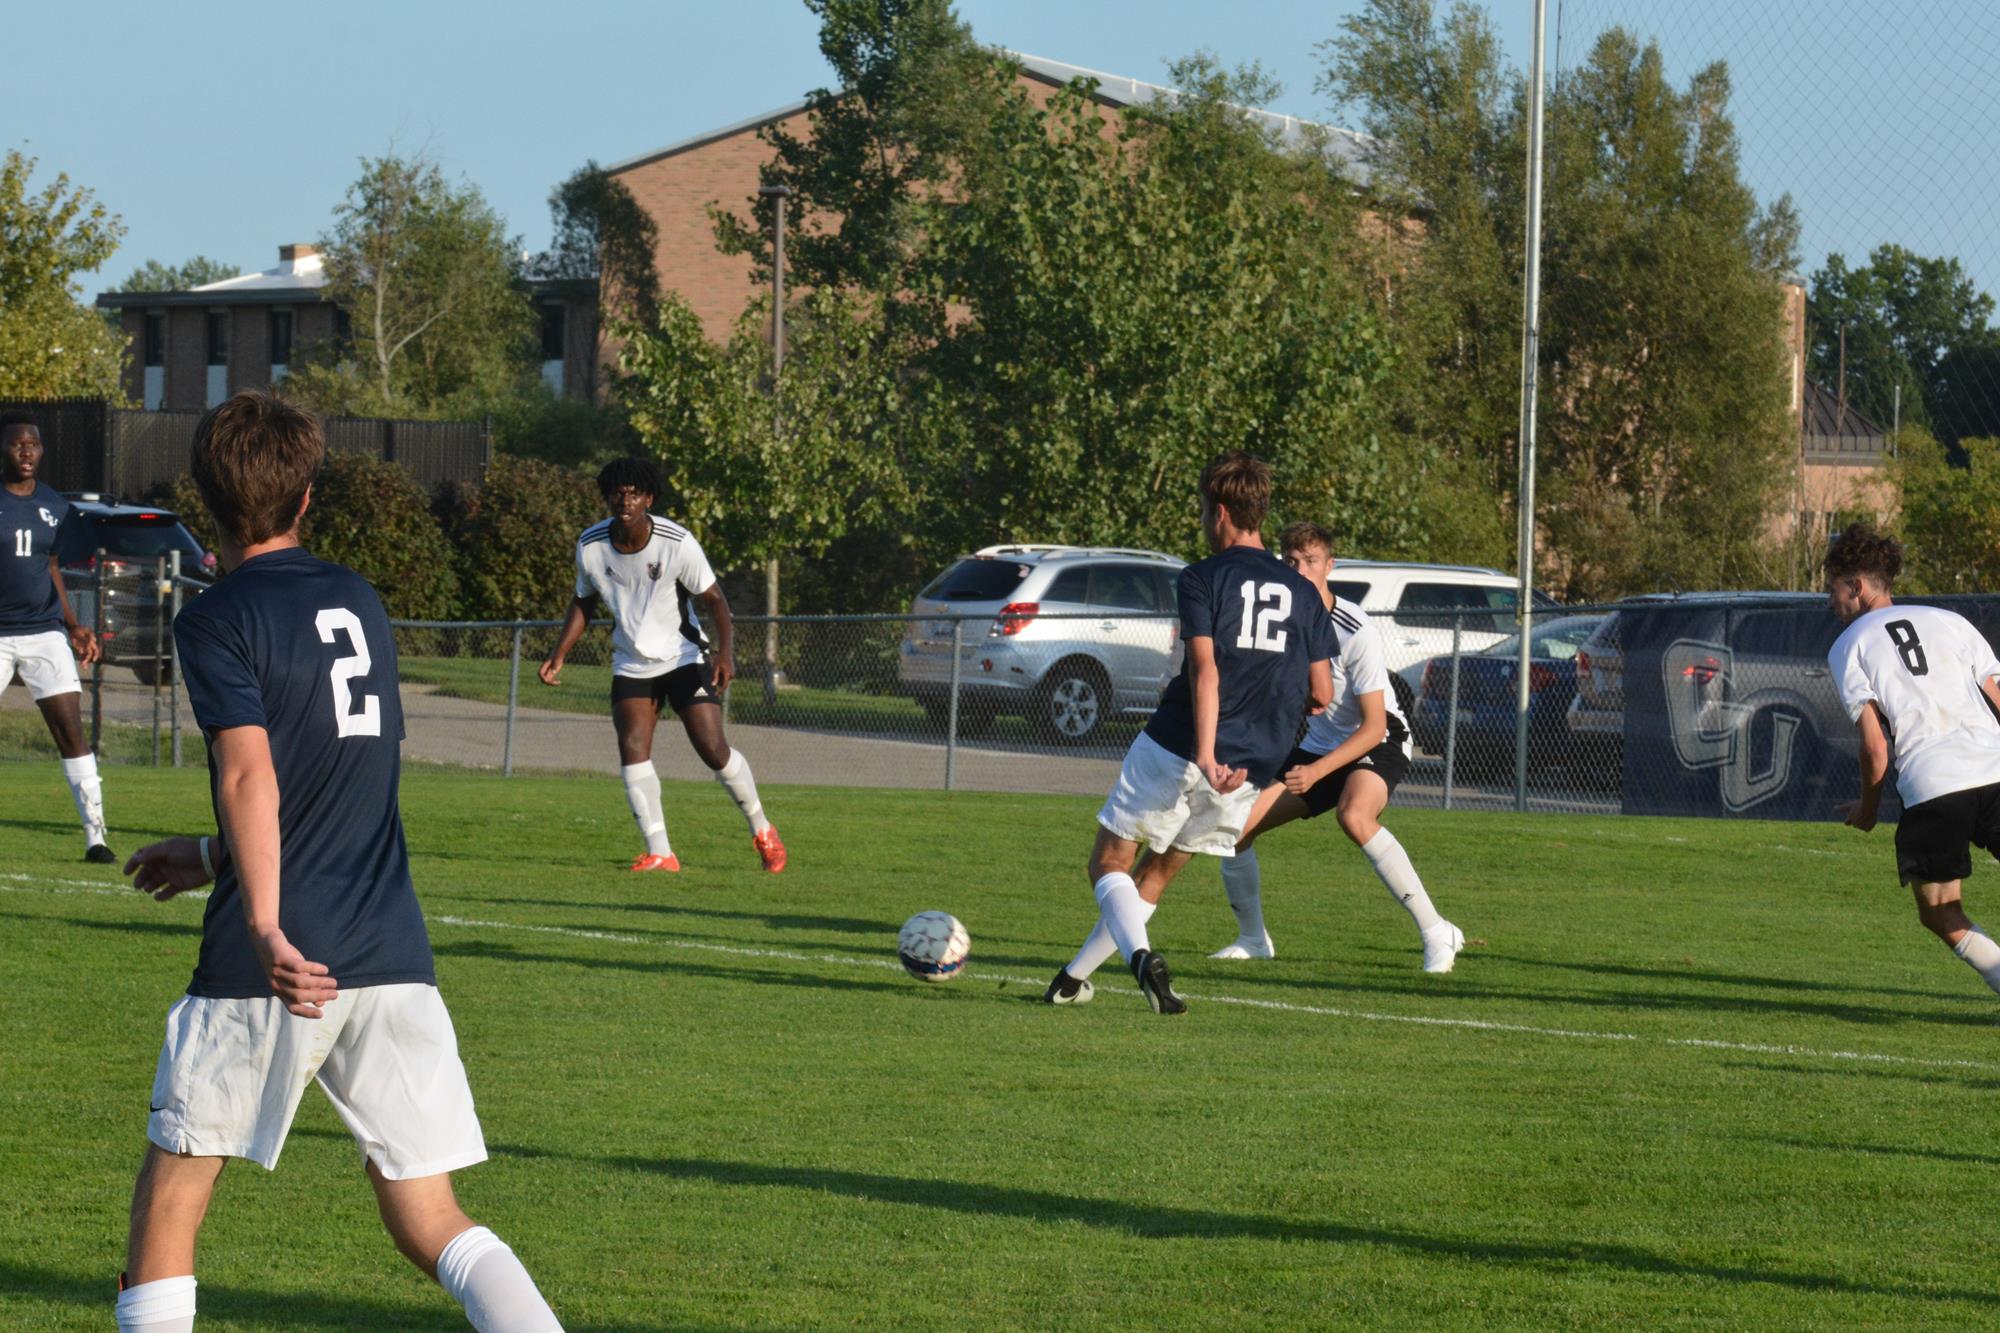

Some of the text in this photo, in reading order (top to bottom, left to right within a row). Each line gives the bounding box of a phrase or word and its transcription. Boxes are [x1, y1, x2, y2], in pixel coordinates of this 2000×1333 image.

[15, 529, 32, 557] 11
[1236, 580, 1292, 653] 12
[1884, 619, 1929, 676] 8
[315, 607, 381, 738] 2
